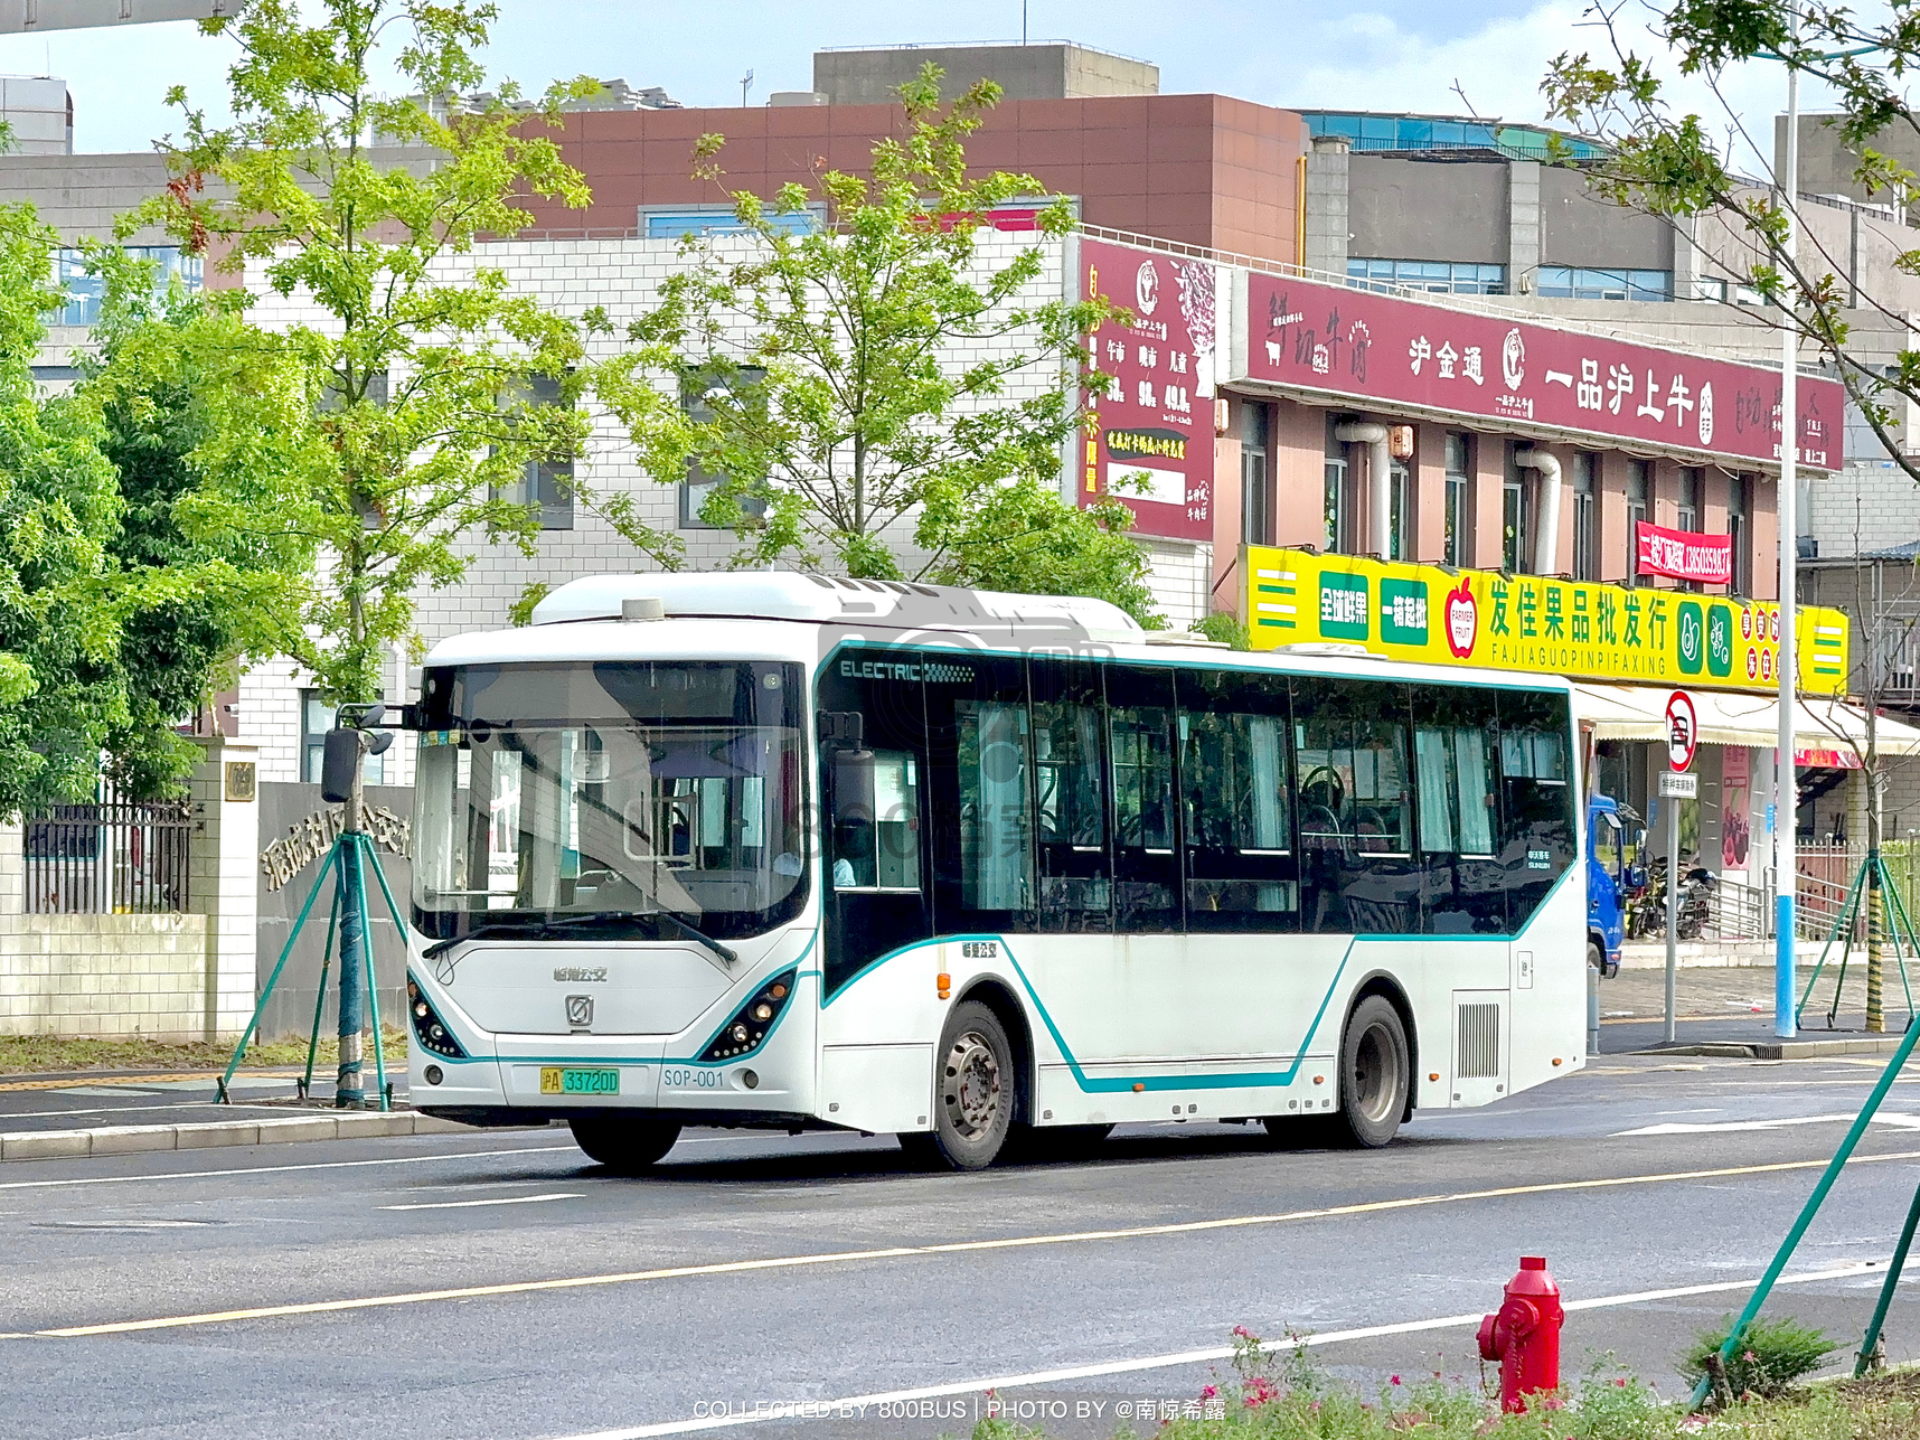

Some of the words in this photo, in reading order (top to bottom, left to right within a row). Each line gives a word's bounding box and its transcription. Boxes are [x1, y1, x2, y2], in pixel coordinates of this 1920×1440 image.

[1107, 339, 1125, 363] 午市
[1139, 345, 1158, 369] 晚市
[1169, 350, 1187, 374] 儿童
[1409, 335, 1484, 386] 沪金通
[1544, 358, 1694, 428] 一品沪上牛
[1321, 587, 1367, 625] 全球鲜果
[1382, 595, 1427, 629] 一箱起批
[1452, 609, 1474, 623] FARMER
[1489, 580, 1667, 651] 发佳果品批发行
[1455, 626, 1470, 639] FRUIT
[841, 660, 921, 681] ELECTRIC
[1492, 643, 1666, 675] FAJIAGUOPINPIFAXING
[565, 1072, 618, 1091] 33720D
[664, 1069, 723, 1087] SOP-001
